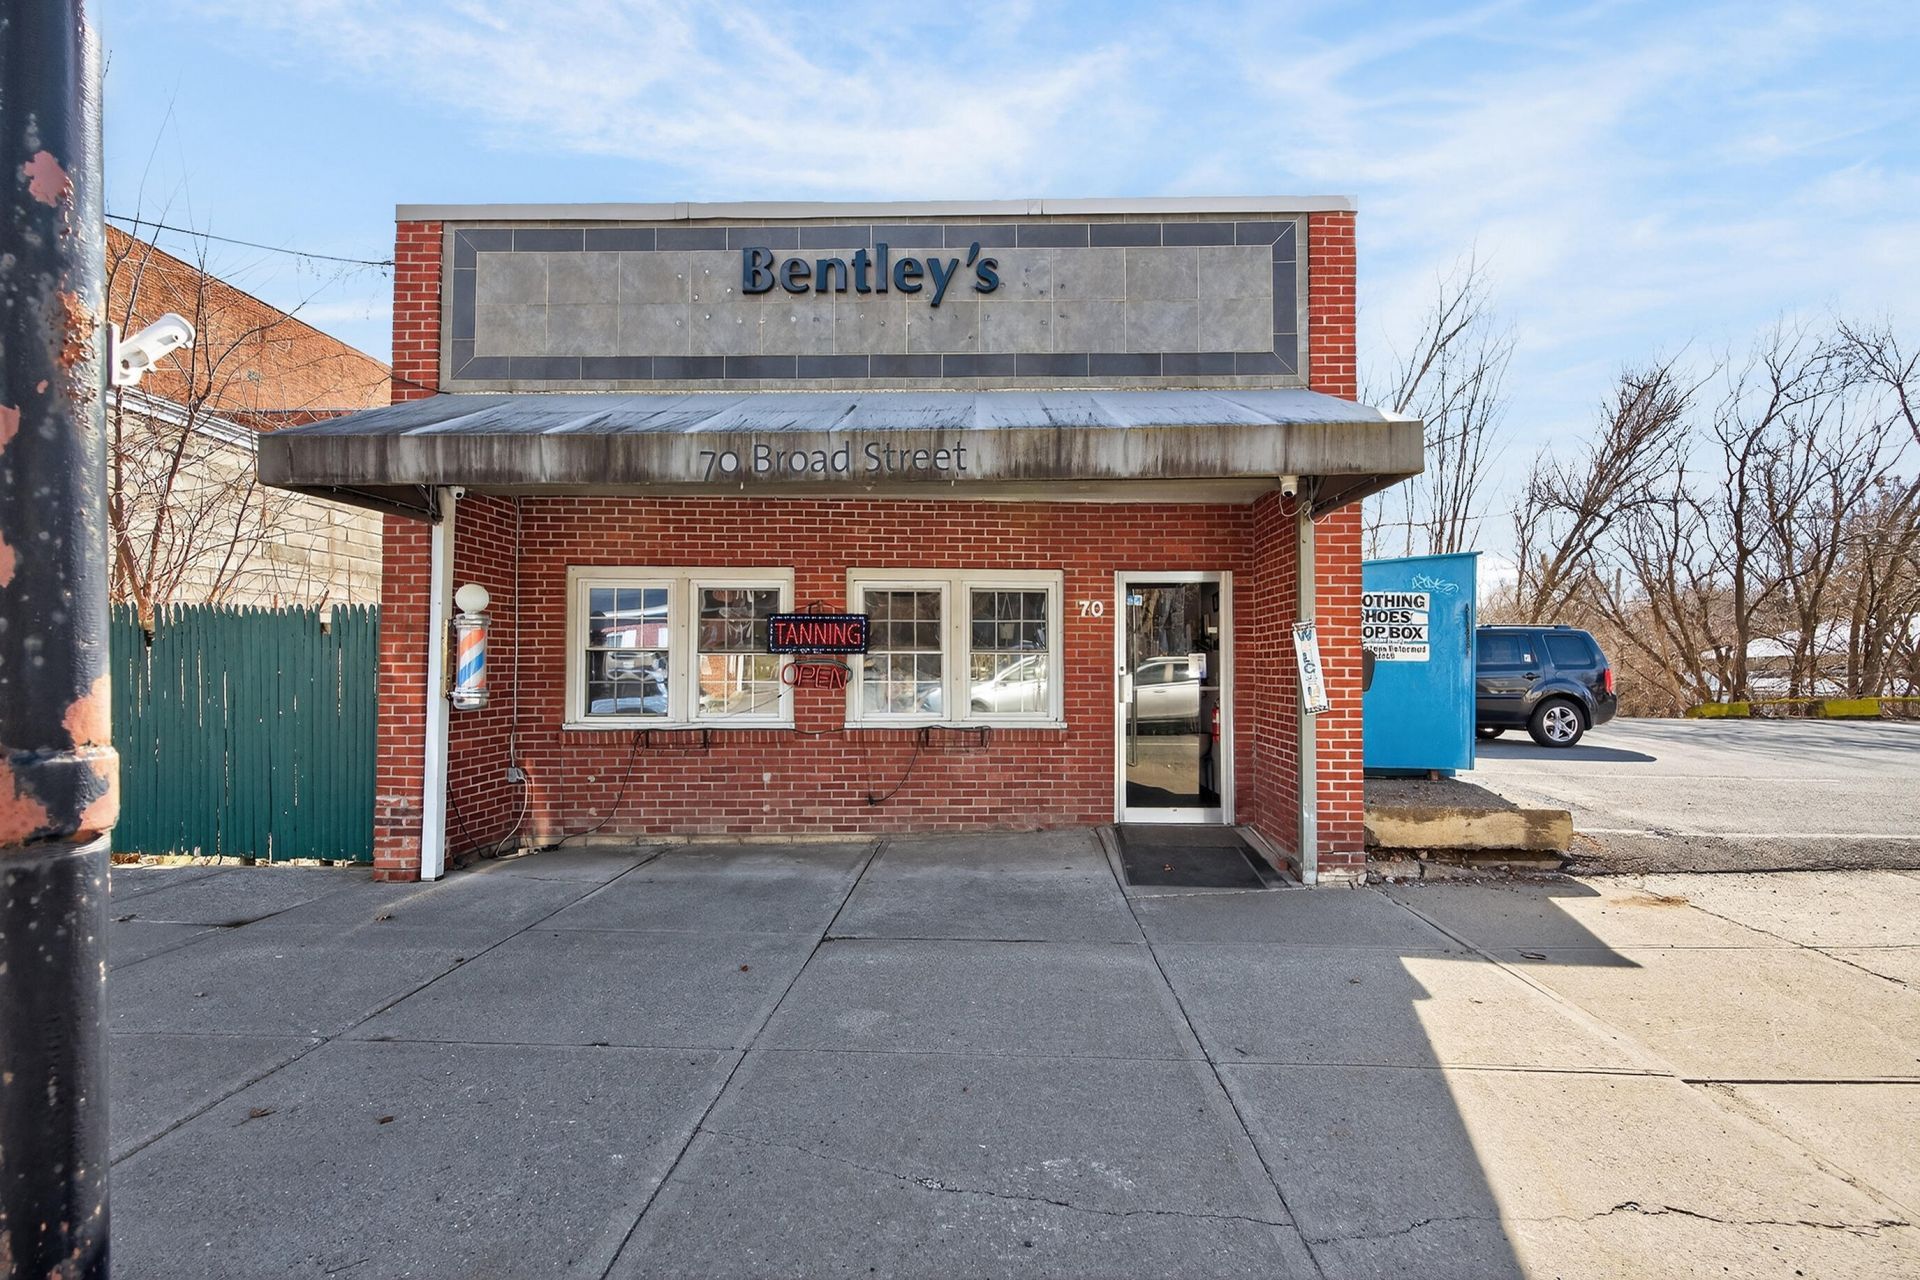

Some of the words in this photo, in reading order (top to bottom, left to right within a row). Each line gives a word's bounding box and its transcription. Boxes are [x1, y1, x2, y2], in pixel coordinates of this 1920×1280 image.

[742, 242, 1000, 308] Bentley's
[700, 450, 739, 482] 70
[753, 441, 849, 473] Broad
[864, 441, 967, 473] Street
[1079, 600, 1104, 618] 70
[775, 622, 861, 645] TANNING
[1389, 626, 1423, 640] BOX
[782, 662, 849, 690] OPEN
